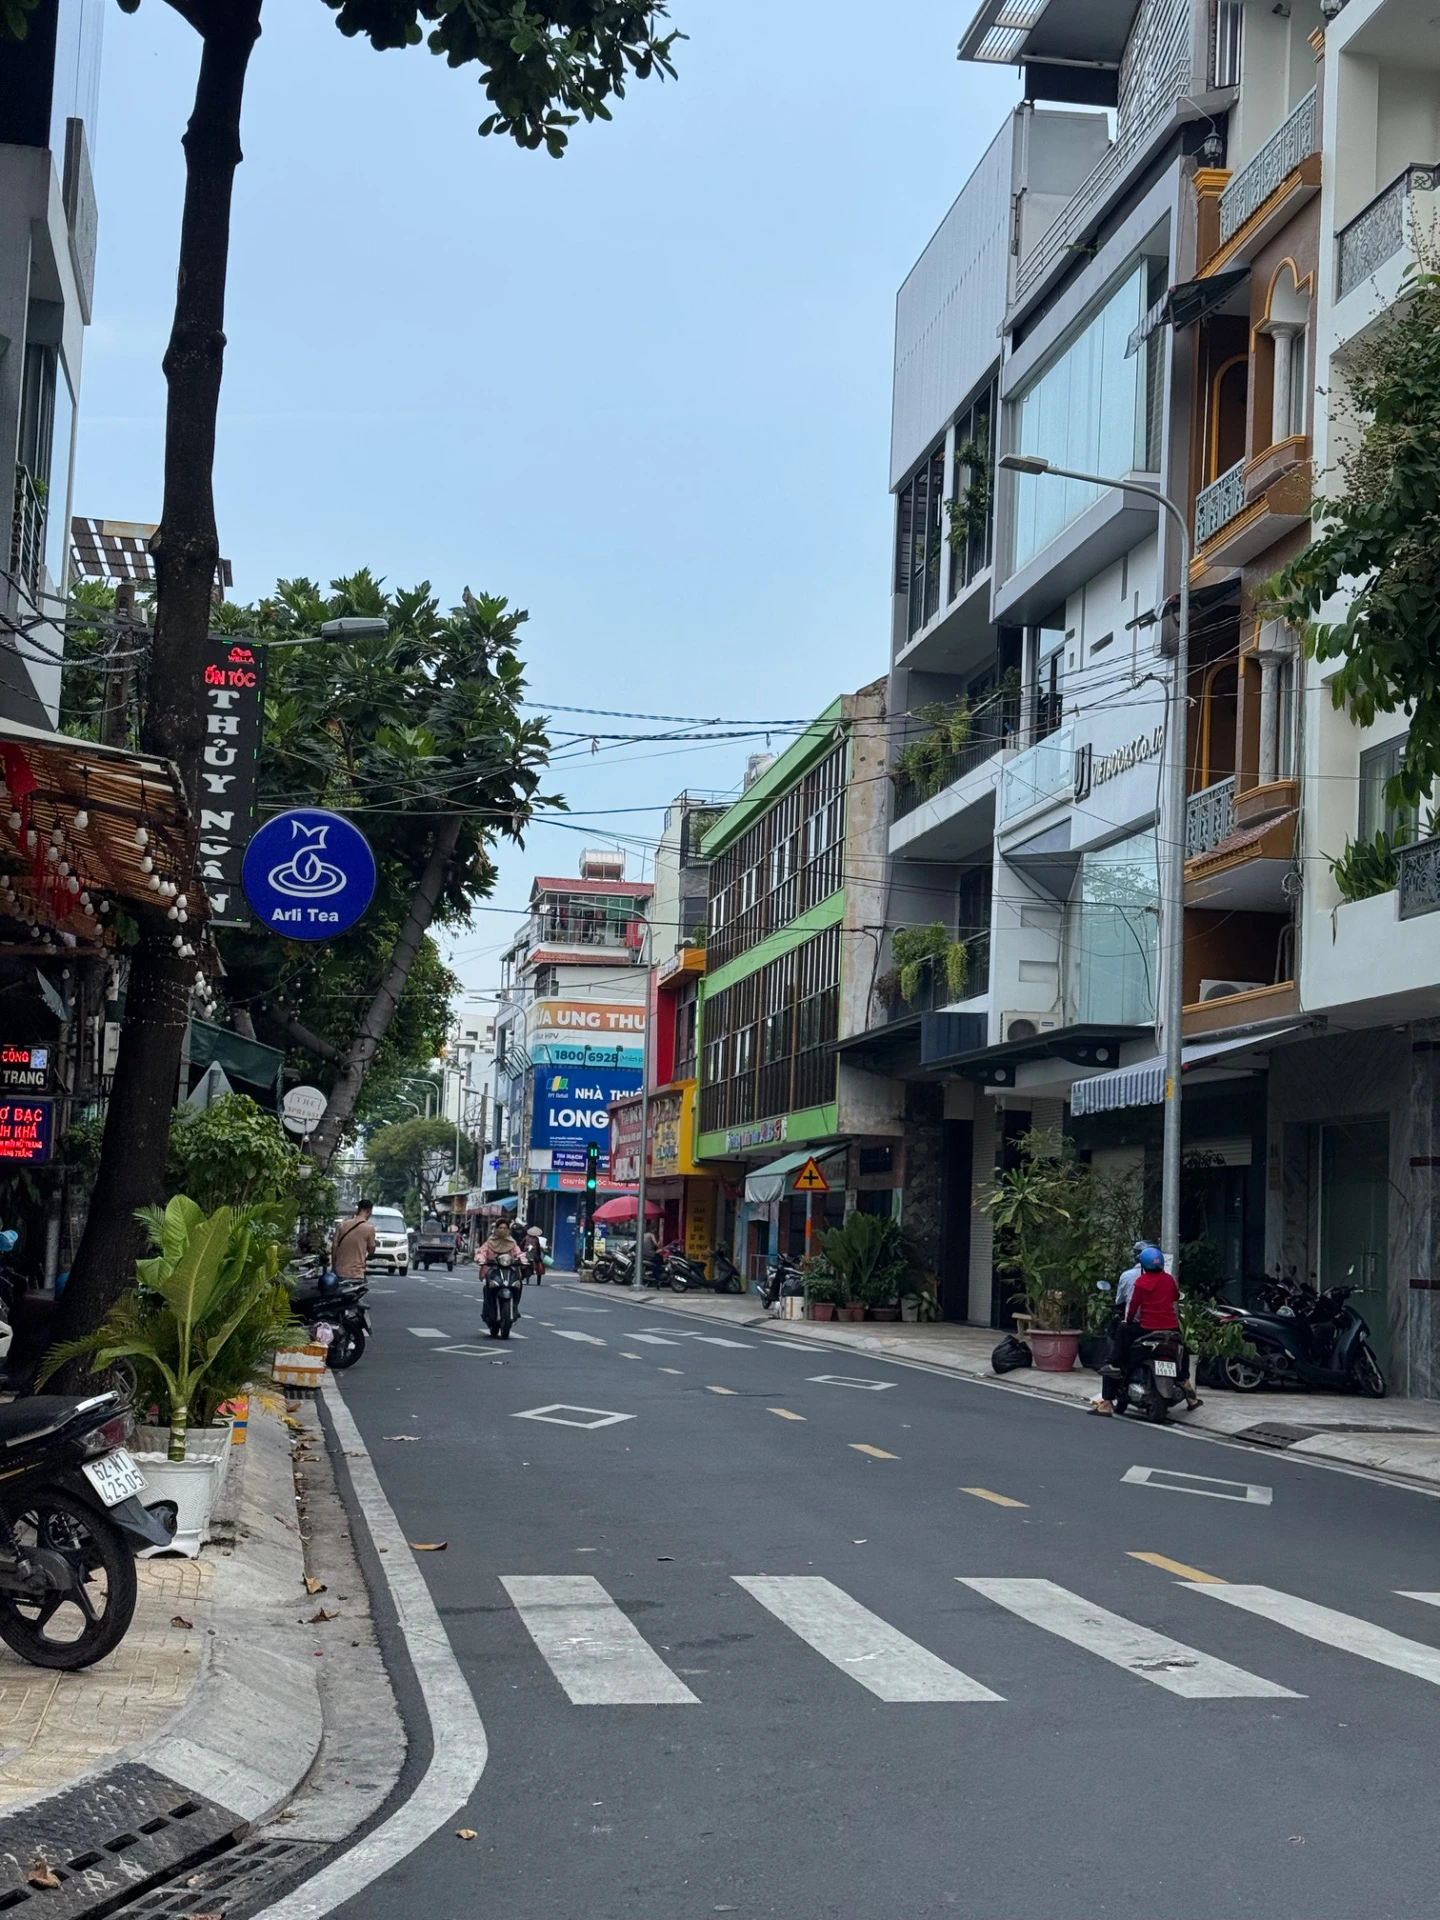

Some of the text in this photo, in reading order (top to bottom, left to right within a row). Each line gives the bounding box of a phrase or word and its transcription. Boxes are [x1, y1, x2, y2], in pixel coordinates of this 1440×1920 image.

[228, 655, 255, 664] WELLA
[228, 668, 256, 688] TÓC
[201, 688, 241, 793] THỦY
[271, 908, 339, 922] Arli Tea
[557, 1009, 601, 1028] UNG
[2, 1047, 29, 1063] CÔNG
[555, 1050, 584, 1061] 1800
[588, 1052, 619, 1064] 6928
[3, 1070, 45, 1086] TRANG
[575, 1085, 604, 1101] NHÀ
[14, 1108, 43, 1124] BẠC
[548, 1108, 610, 1129] LONG
[14, 1122, 37, 1139] KHÁ
